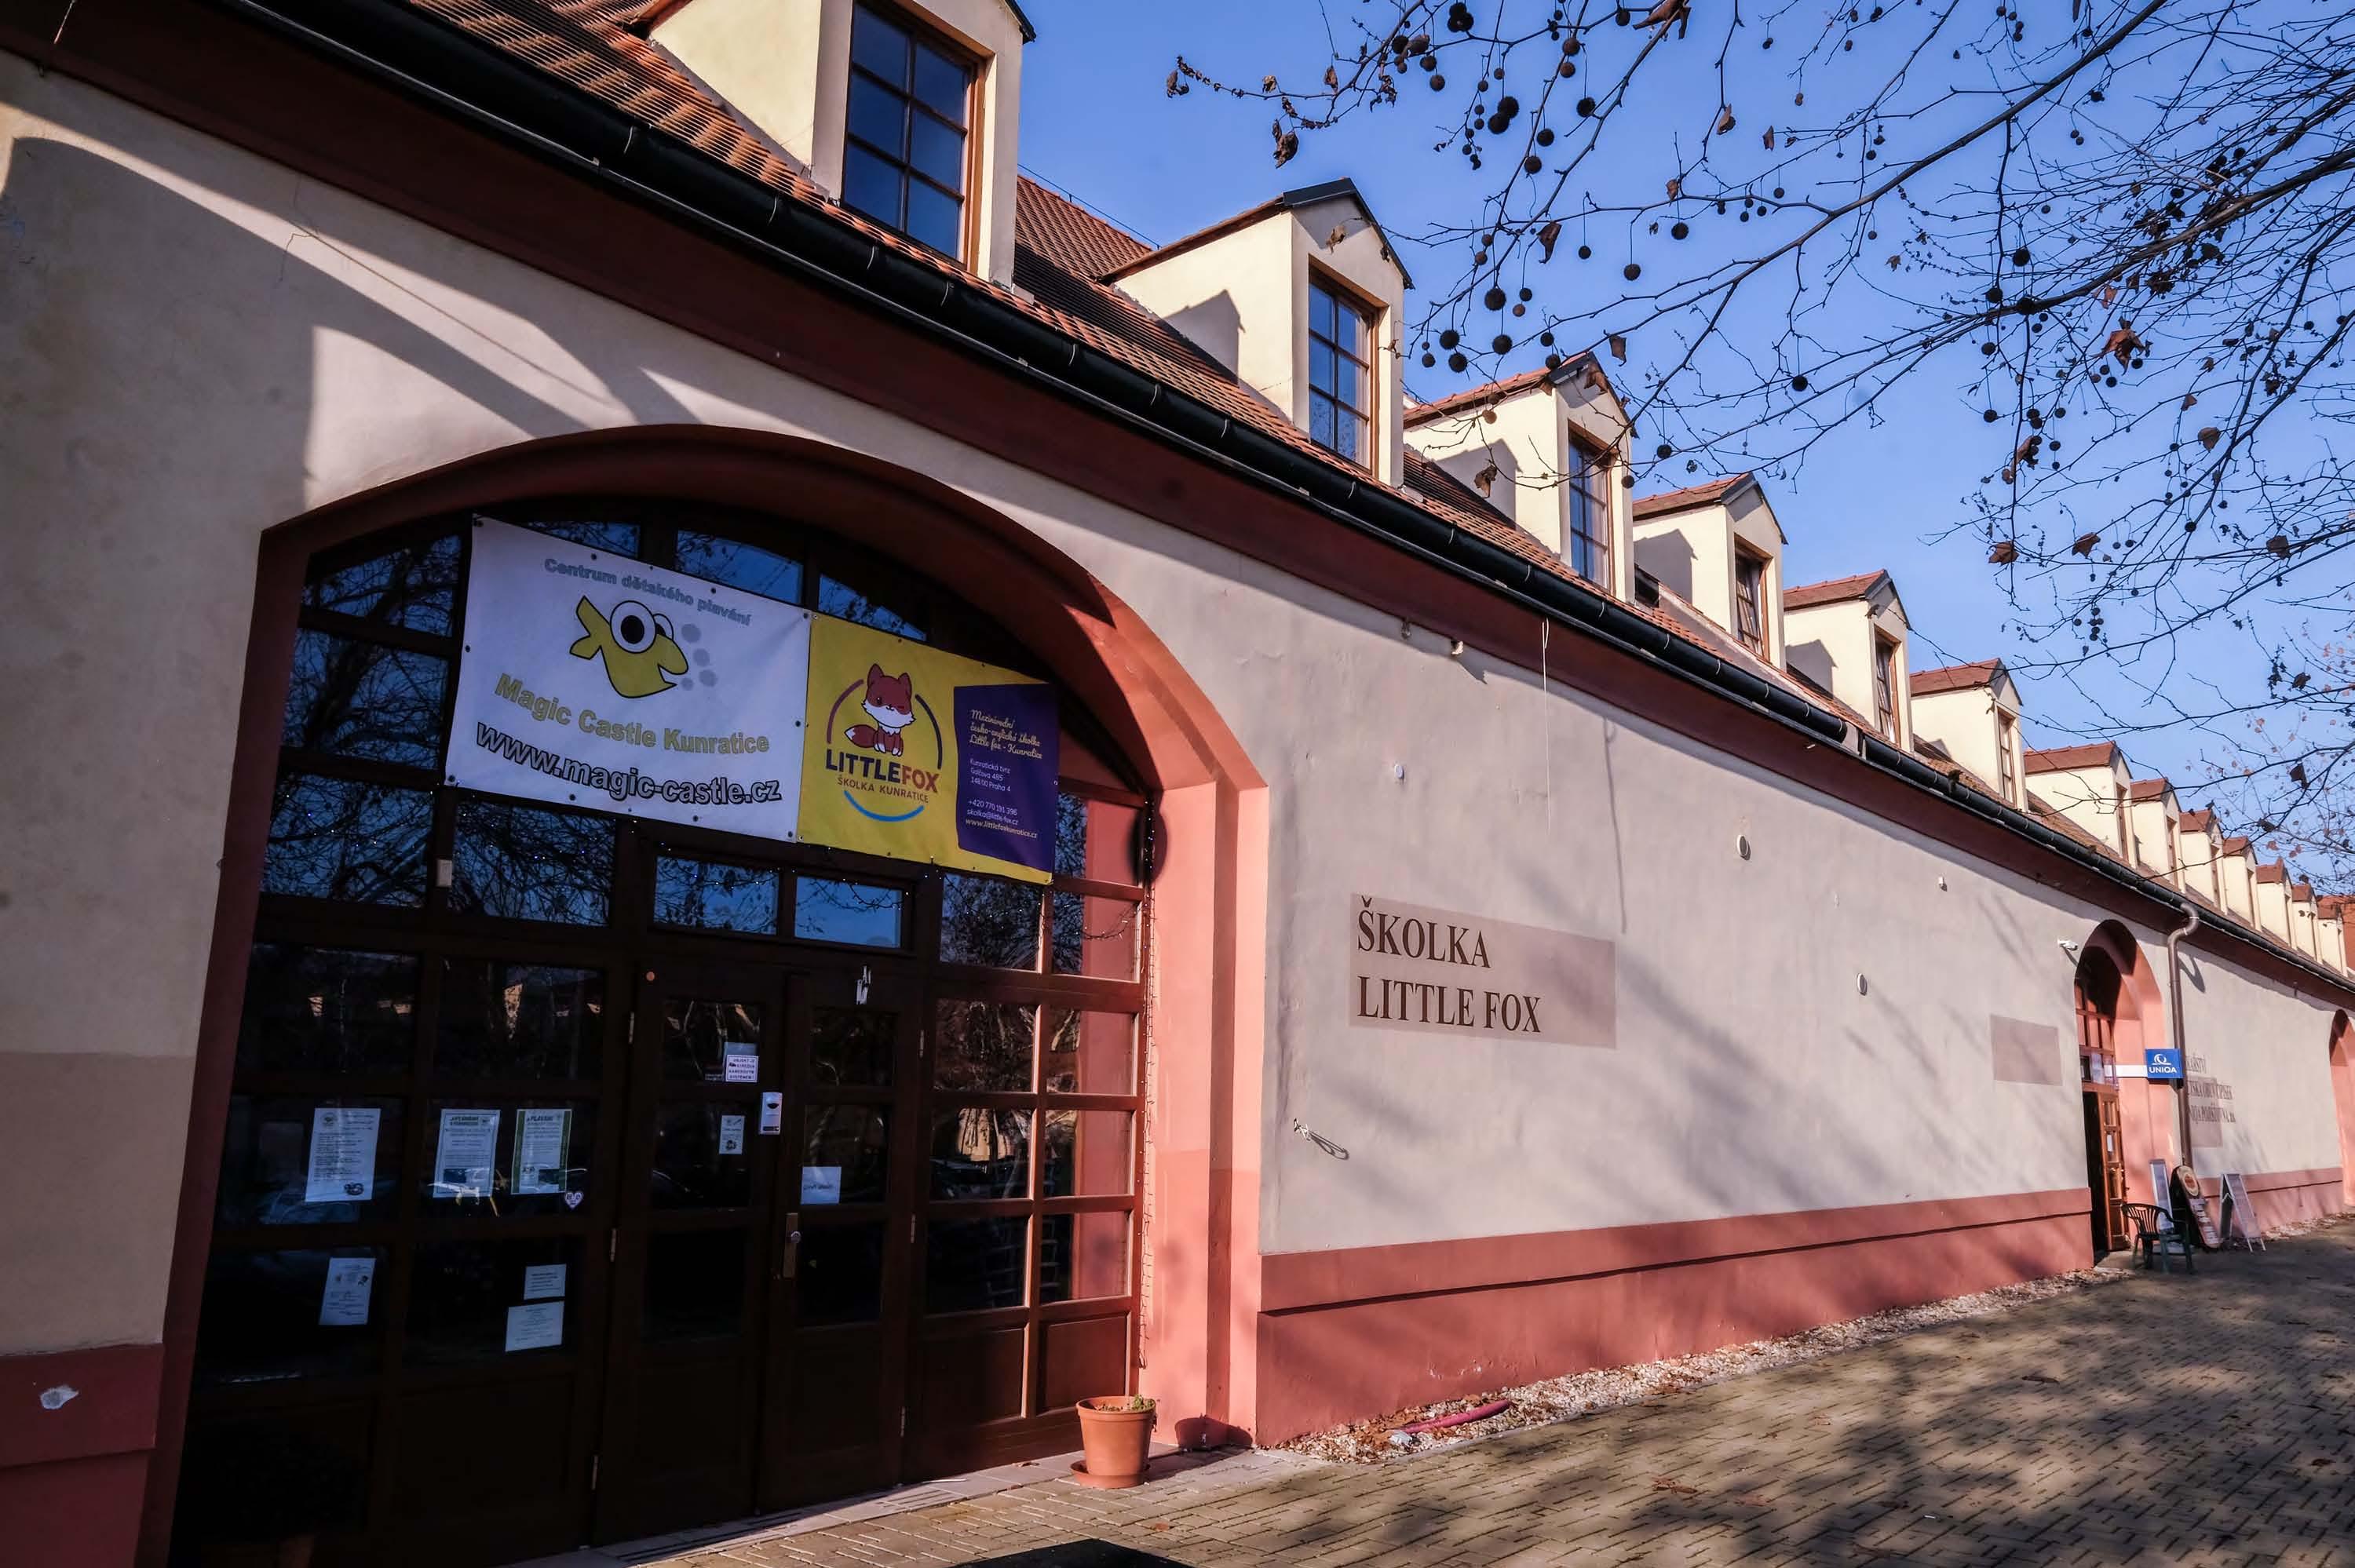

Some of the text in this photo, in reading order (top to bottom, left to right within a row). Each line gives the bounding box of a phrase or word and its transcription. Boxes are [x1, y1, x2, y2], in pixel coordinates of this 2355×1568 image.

[545, 558, 751, 626] Centrum dětského plavání
[495, 673, 769, 754] Magic Castle Kunratice
[476, 721, 782, 805] www.magic-castle.cz
[838, 775, 929, 804] ŠKOLKA KUNRATICE
[1357, 895, 1492, 968] ŠKOLKA
[1357, 975, 1541, 1033] LITTLE FOX
